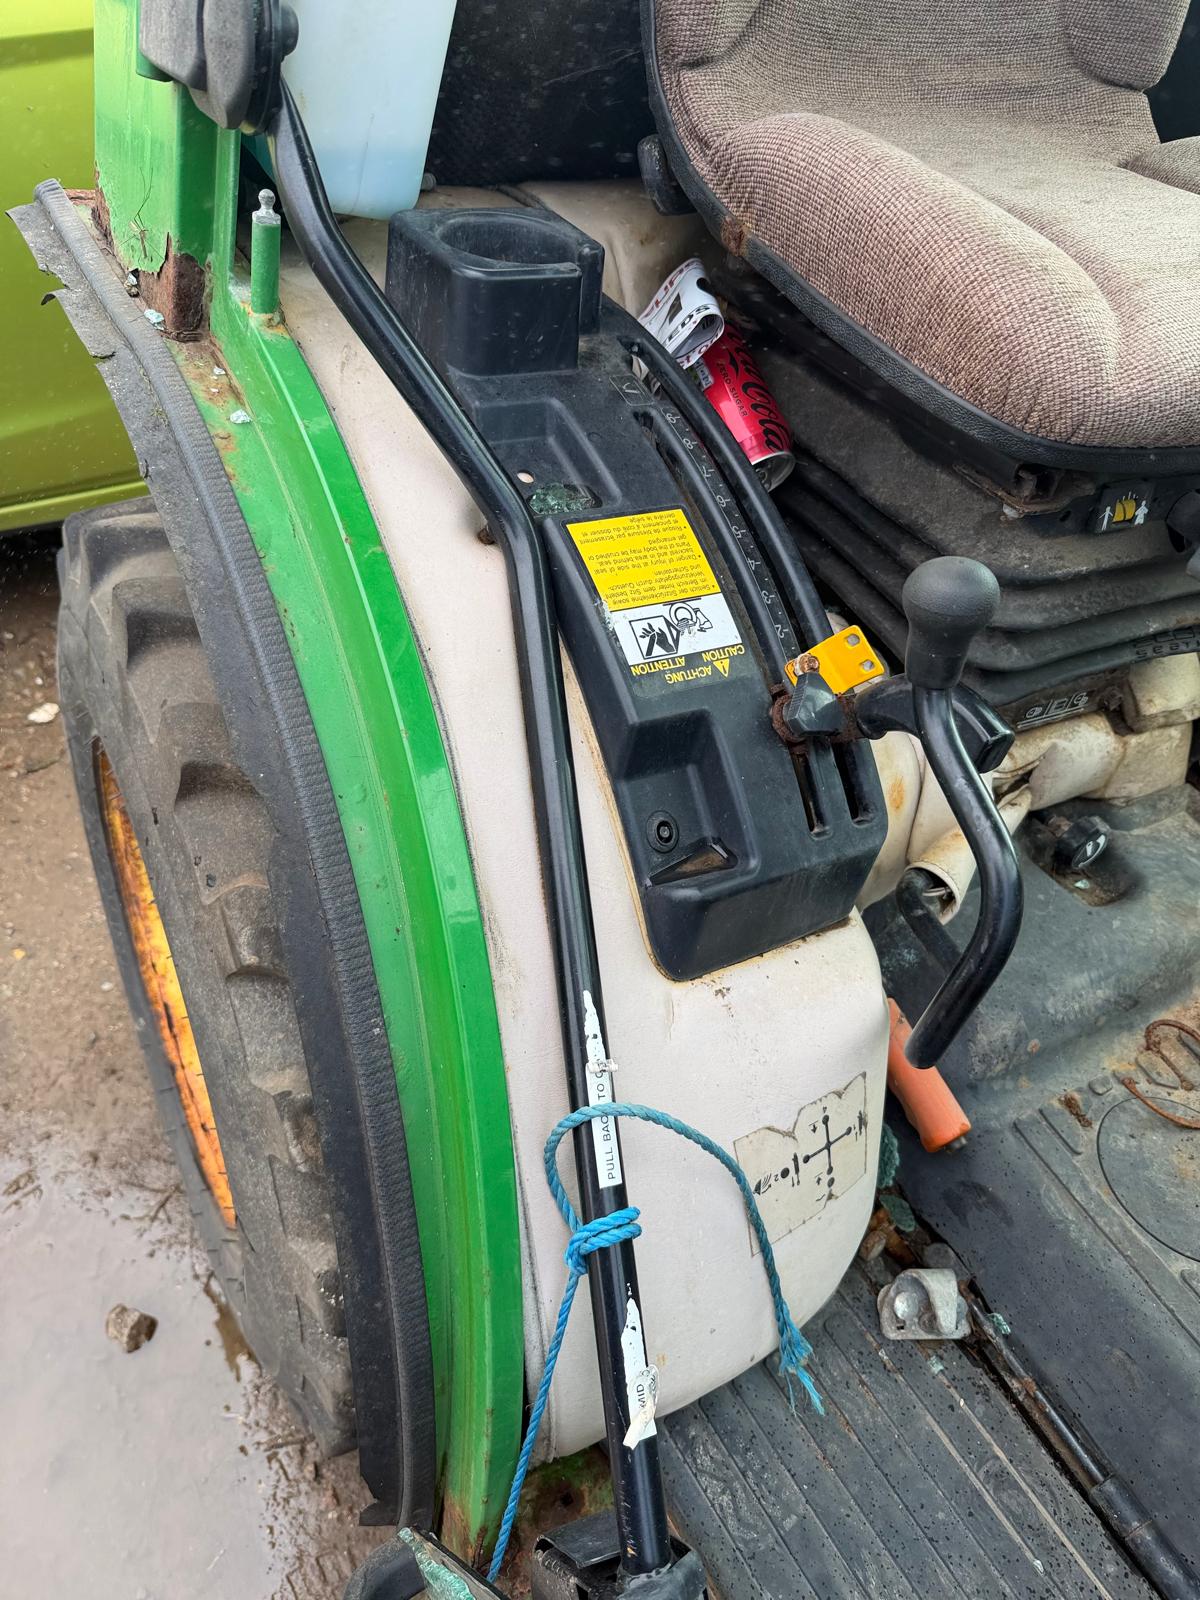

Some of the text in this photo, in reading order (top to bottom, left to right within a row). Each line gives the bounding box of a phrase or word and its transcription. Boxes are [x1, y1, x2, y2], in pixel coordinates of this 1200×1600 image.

[730, 387, 748, 417] SUGAR
[683, 438, 694, 450] 8
[716, 494, 727, 508] 6
[732, 525, 743, 540] 5
[595, 552, 620, 560] crushed
[613, 557, 634, 565] behind
[650, 558, 667, 566] injury
[747, 557, 757, 571] 4
[636, 579, 653, 587] durch
[761, 590, 772, 605] 3
[774, 624, 785, 639] 2
[630, 644, 745, 676] CAUTION ATTENTION
[665, 665, 713, 684] ACHTUNG
[597, 1083, 606, 1100] TO
[601, 1113, 612, 1142] BAC
[604, 1147, 615, 1180] PULL
